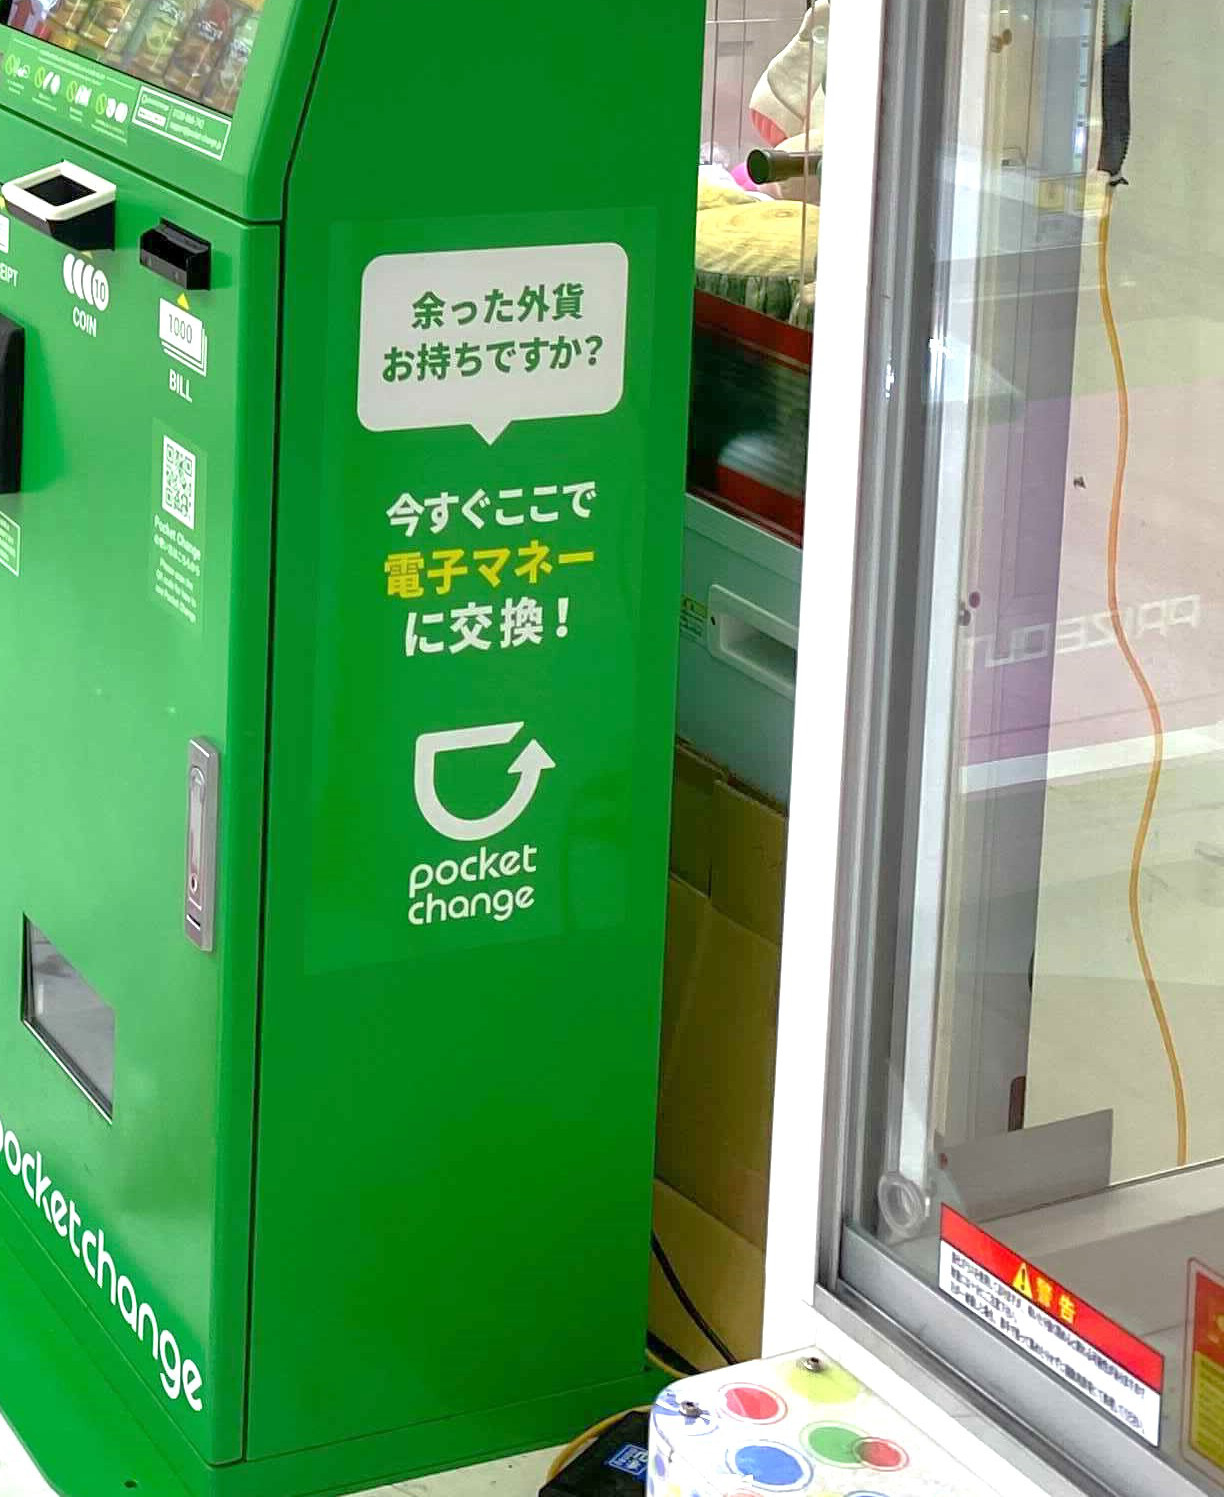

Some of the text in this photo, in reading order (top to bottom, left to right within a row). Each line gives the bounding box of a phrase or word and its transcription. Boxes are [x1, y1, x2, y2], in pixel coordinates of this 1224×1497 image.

[93, 274, 107, 302] 10
[411, 282, 585, 331] 余った外貨
[72, 305, 98, 338] COIN
[168, 311, 194, 345] 1000
[382, 333, 605, 385] お持ちですか?
[168, 368, 193, 403] BILL
[385, 481, 598, 539] 今すぐここで
[383, 538, 596, 600] 電子マネー
[404, 597, 571, 658] に交換!
[408, 844, 538, 899] pocket
[407, 884, 536, 926] change
[1036, 1275, 1076, 1326] 警告
